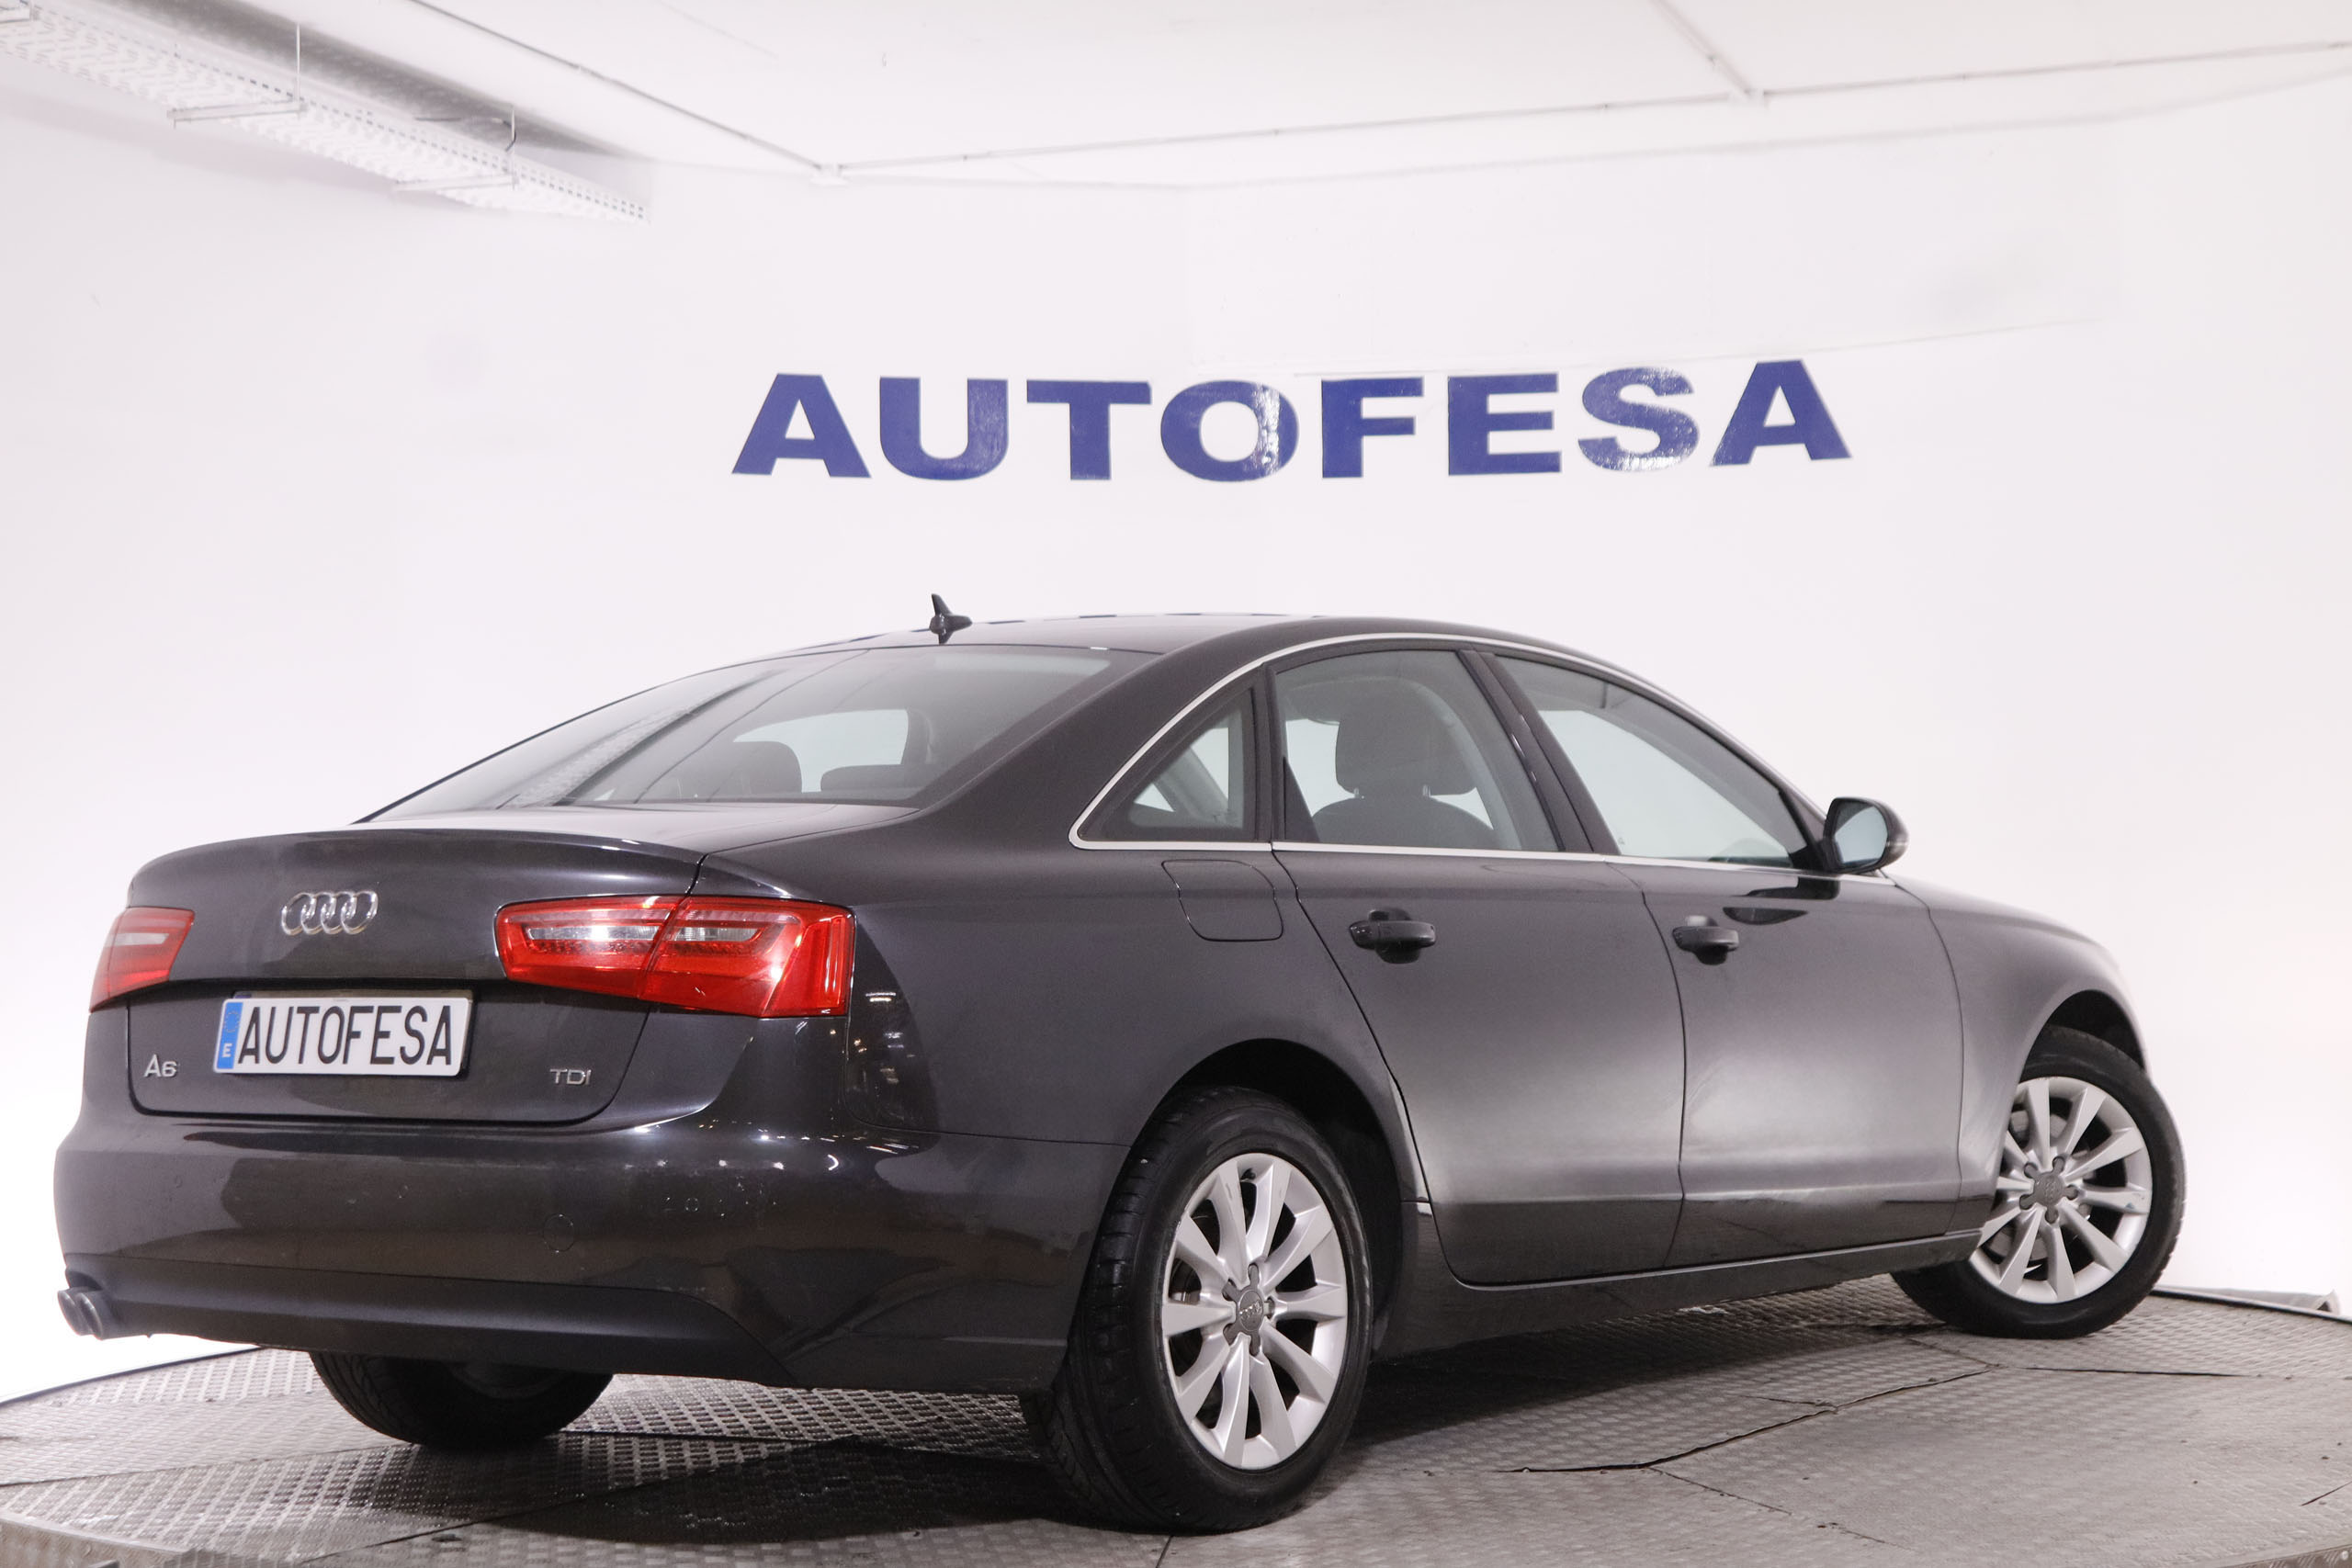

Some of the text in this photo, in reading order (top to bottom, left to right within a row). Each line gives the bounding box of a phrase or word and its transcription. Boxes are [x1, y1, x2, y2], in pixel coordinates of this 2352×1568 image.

[731, 359, 1851, 481] AUTOFESA
[238, 1005, 451, 1066] AUTOFESA
[221, 1043, 233, 1058] E
[143, 1055, 179, 1078] A6
[549, 1067, 592, 1087] TDI
